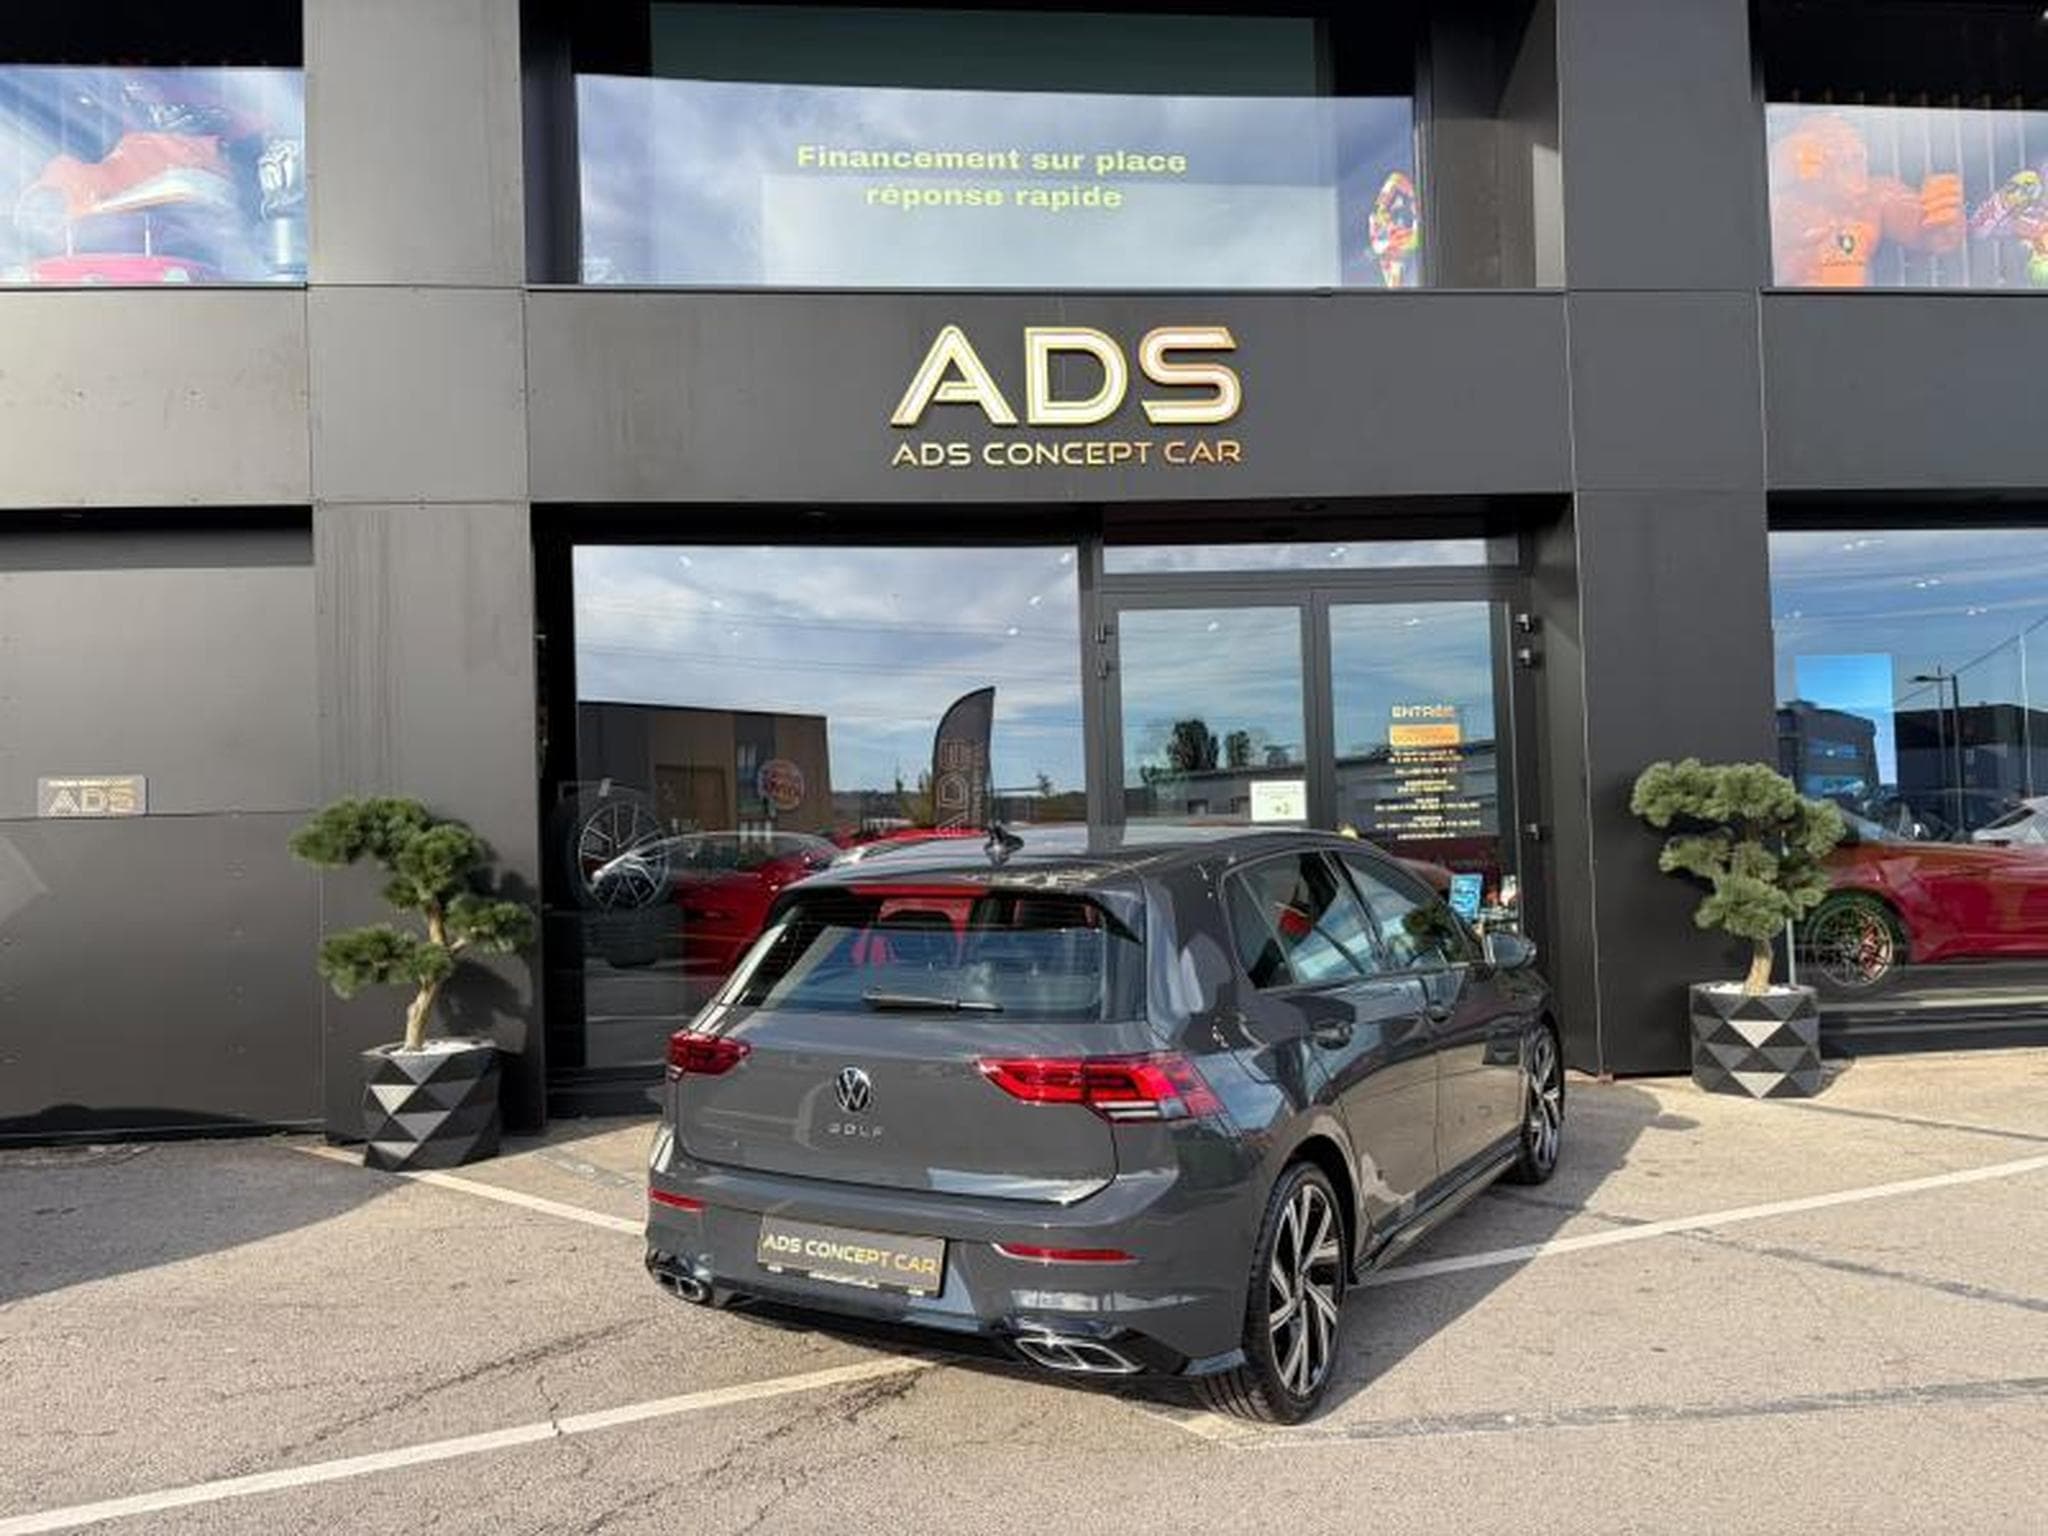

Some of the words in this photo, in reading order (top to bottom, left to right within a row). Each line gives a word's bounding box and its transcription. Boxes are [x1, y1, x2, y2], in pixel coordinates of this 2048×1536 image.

[797, 145, 1020, 169] Financement
[1032, 151, 1085, 172] sur
[1095, 150, 1188, 175] place
[866, 184, 1004, 211] réponse
[1016, 184, 1123, 212] rapide
[890, 325, 1242, 425] ADS
[892, 442, 971, 466] ADS
[982, 442, 1153, 465] CONCEPT
[1163, 441, 1242, 464] CAR
[48, 788, 135, 815] ADS
[762, 1234, 801, 1253] ADS
[805, 1240, 894, 1268] CONCEPT
[895, 1254, 937, 1275] CAR
